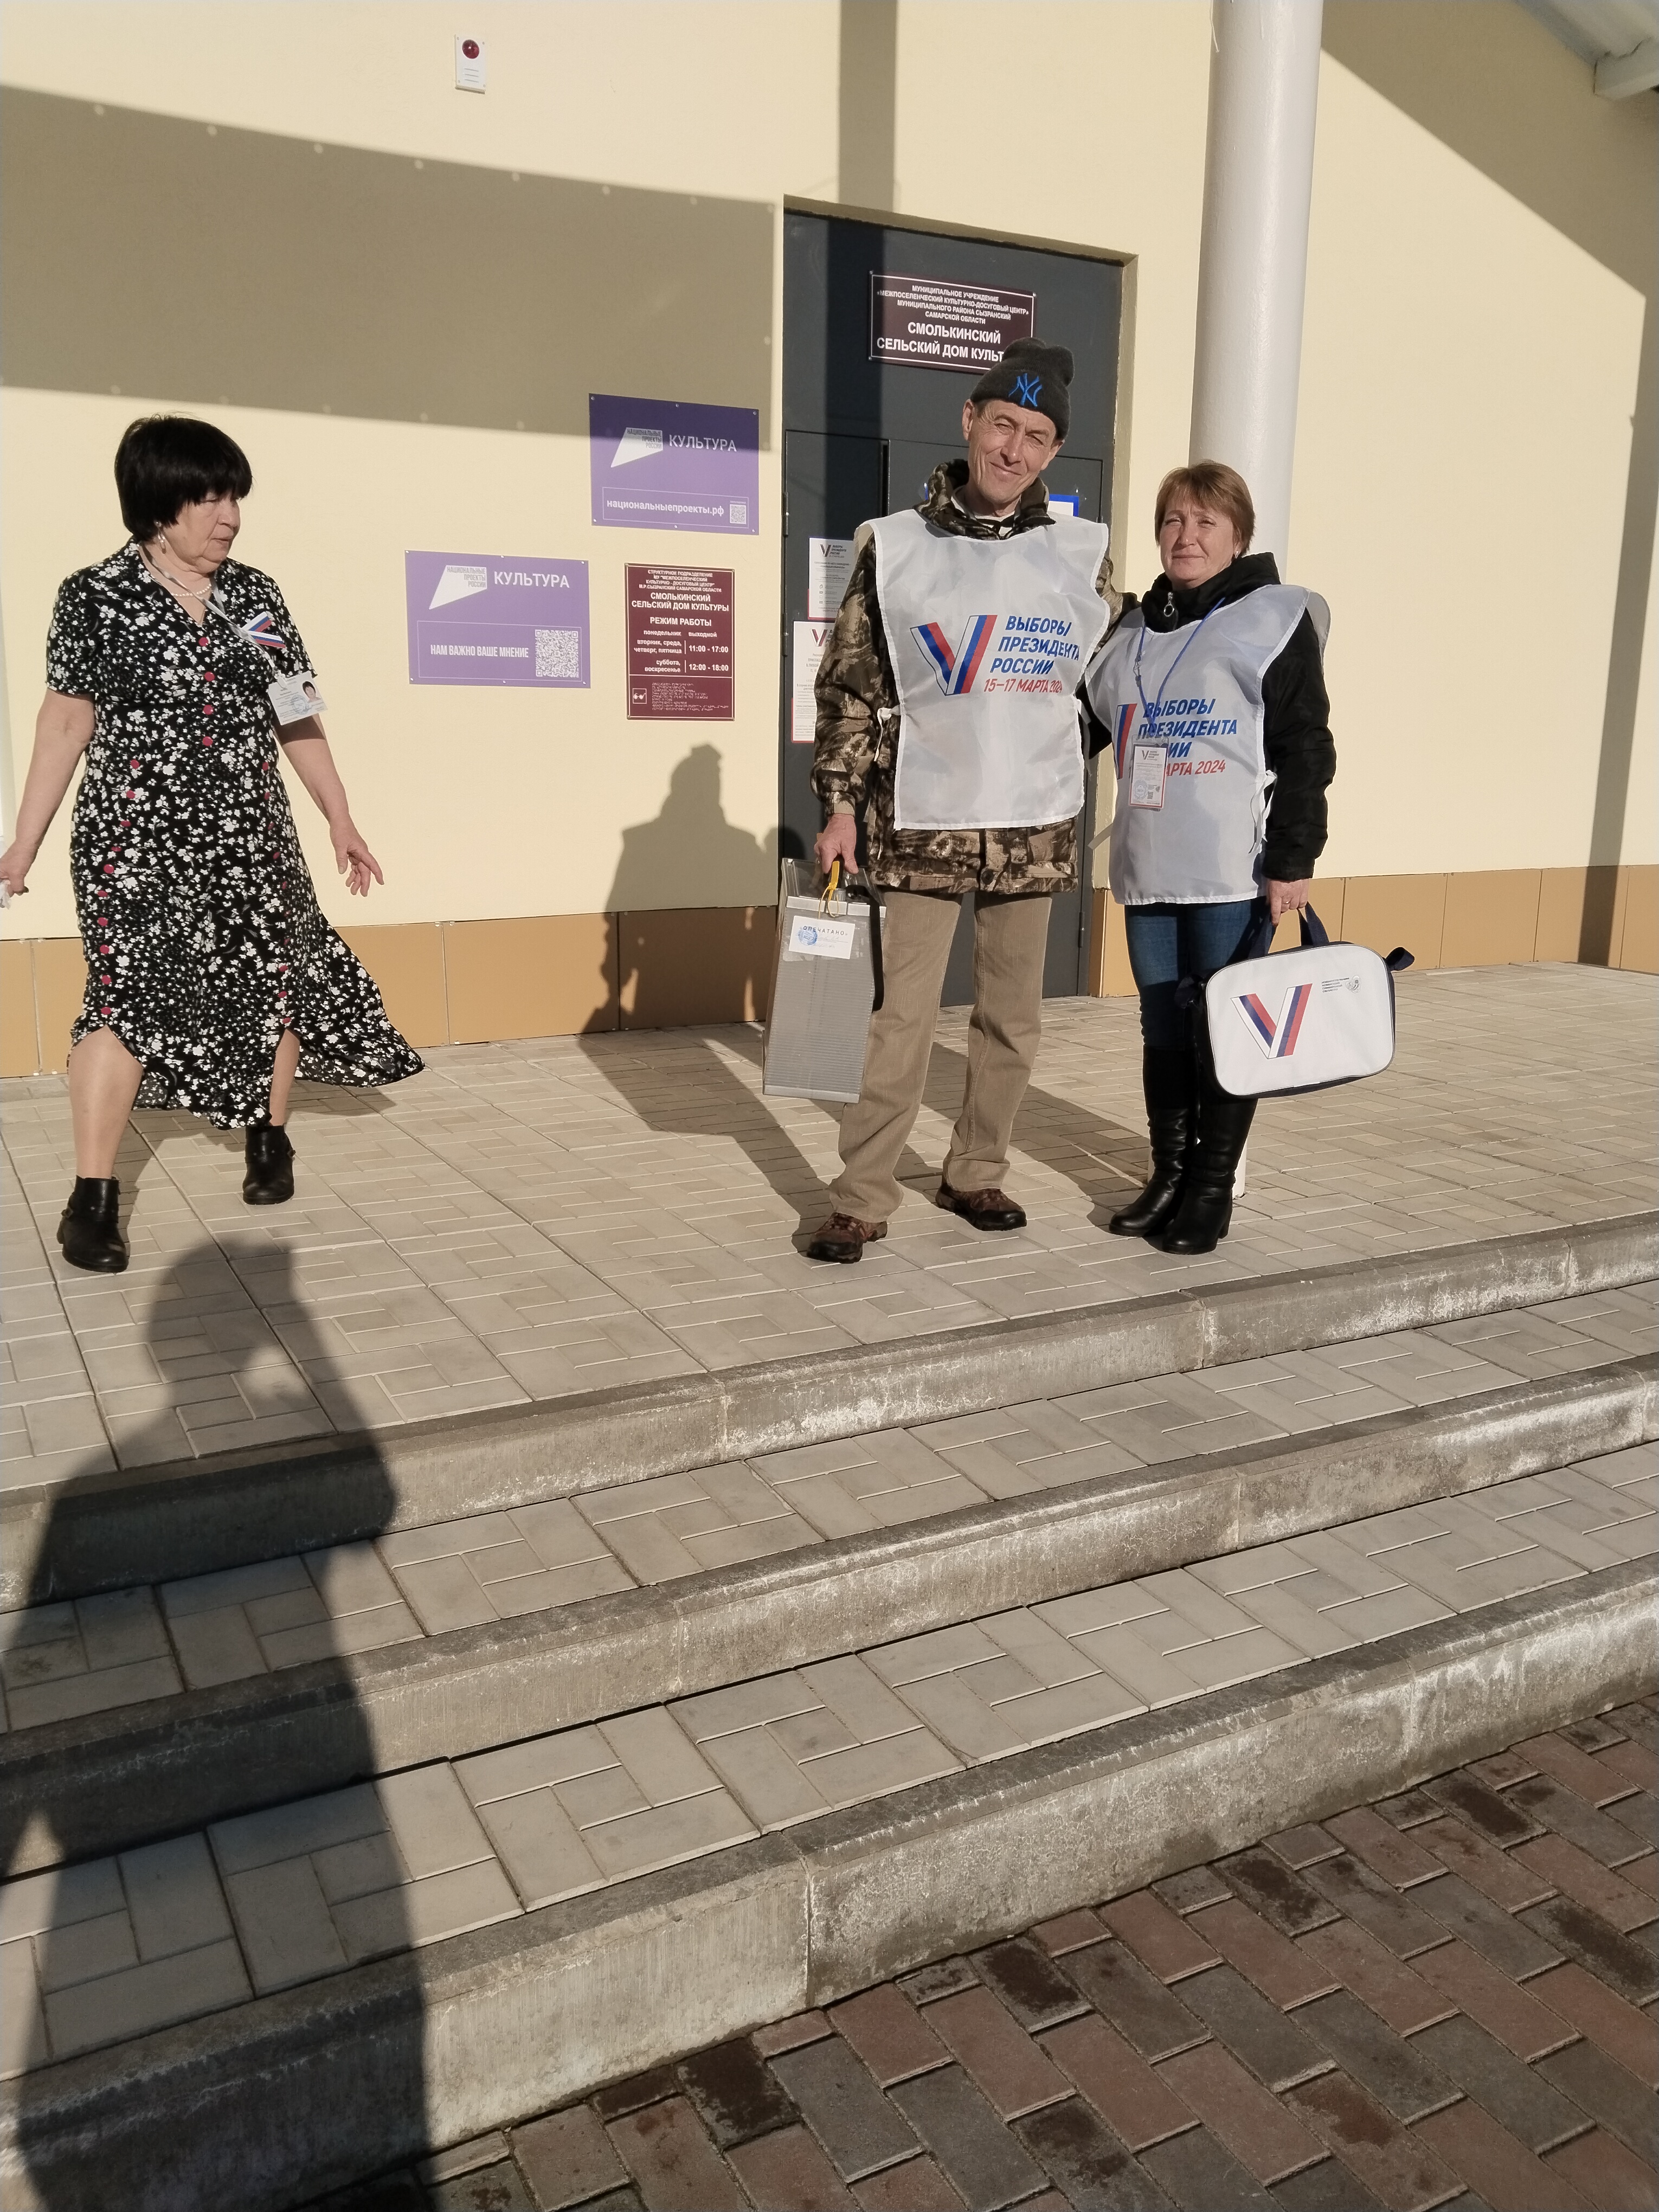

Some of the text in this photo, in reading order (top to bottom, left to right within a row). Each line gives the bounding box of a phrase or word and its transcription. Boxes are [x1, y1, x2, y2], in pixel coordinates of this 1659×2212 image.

[912, 285, 999, 303] МУНИЦИПАЛЬНОЕ УЧРЕЖДЕНИЕ
[897, 299, 1011, 320] МУНИЦИПАЛЬНОГО РАЙОНА СЫЗРАНСКИЙ
[925, 311, 986, 324] САМАРСКОЙ ОБЛАСТИ
[908, 322, 1001, 344] СМОЛЬКИНСКИЙ
[877, 337, 1005, 362] СЕЛЬСКИЙ ДОМ КУЛЬТ
[668, 434, 737, 452] КУЛЬТУРА
[607, 499, 724, 517] национальныепроекты.рф
[447, 566, 486, 575] НАЦИОНАЛЬНЫЕ
[494, 571, 570, 588] КУЛЬТУРА
[651, 592, 711, 602] СМОЛЬКИНСКИЙ
[632, 600, 729, 612] СЕЛЬСКИЙ ДОМ КУЛЬТУРЫ
[650, 617, 712, 626] РЕЖИМ РАБОТЫ
[1005, 615, 1072, 636] ВЫБОРЫ
[430, 645, 529, 658] НАМ ВАЖНО ВАШЕ МНЕНИЕ
[998, 636, 1080, 661] ПРЕЗИДЕНТА
[990, 658, 1054, 674] РОССИИ
[1016, 679, 1049, 693] МАРТА
[1142, 698, 1216, 718] ВЫБОРЫ
[1166, 760, 1225, 776] АРТА 2024
